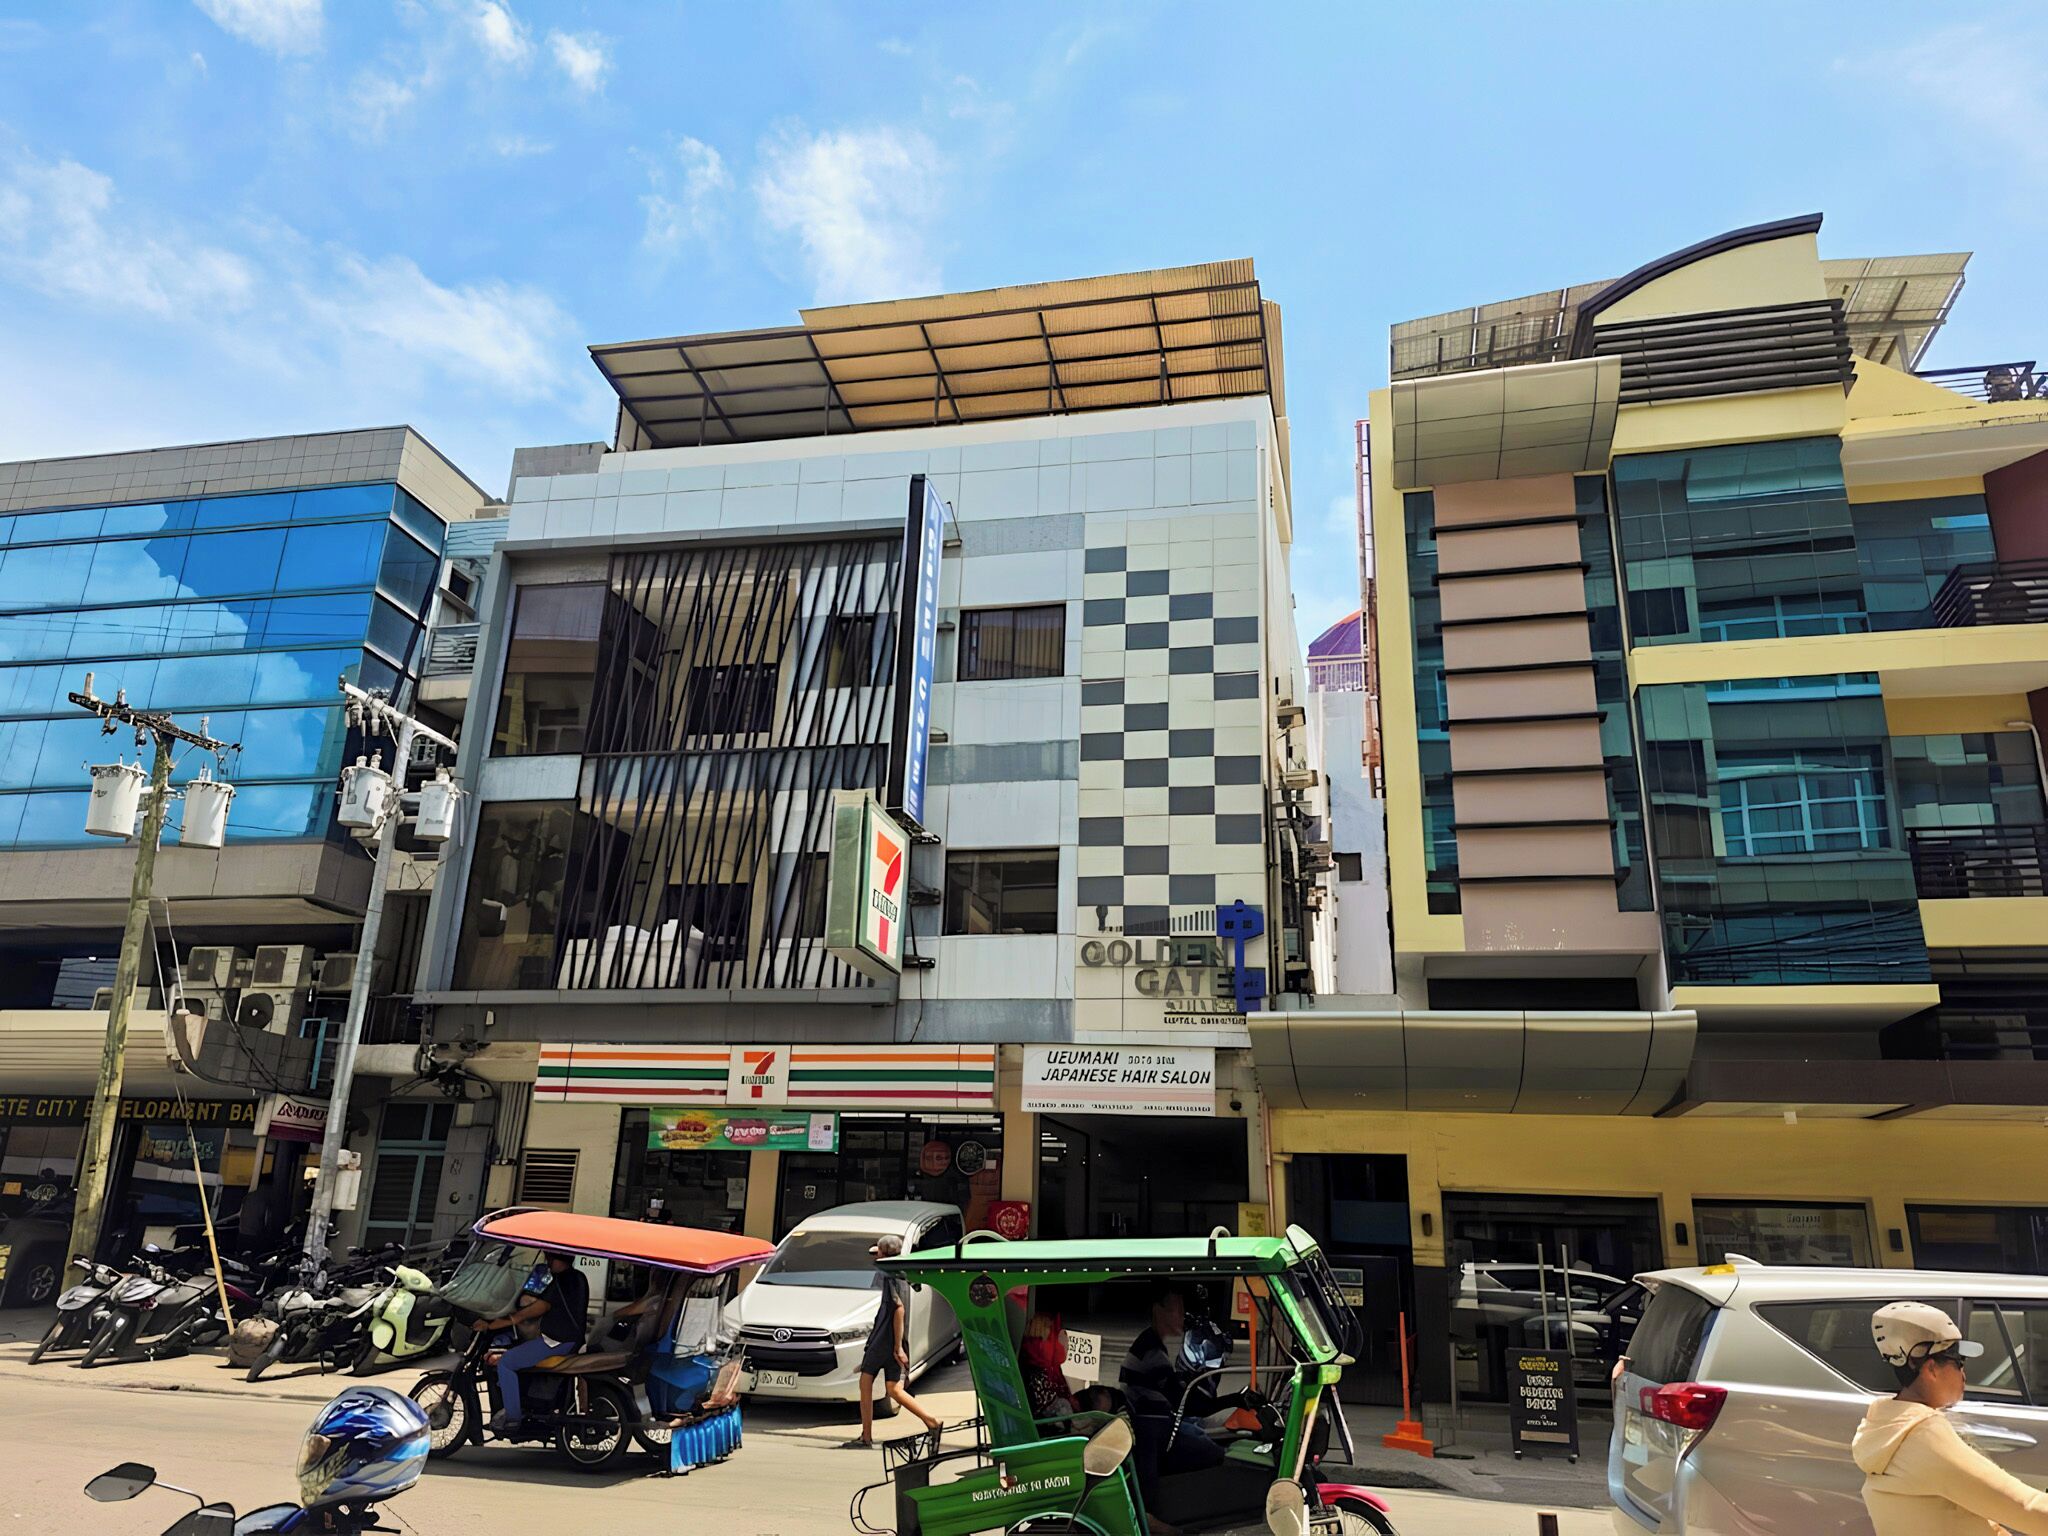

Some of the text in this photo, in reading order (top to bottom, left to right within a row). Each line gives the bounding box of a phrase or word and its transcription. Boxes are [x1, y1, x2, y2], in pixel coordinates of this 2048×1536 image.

[1041, 1068, 1117, 1083] JAPANESE
[1160, 1070, 1211, 1085] SALON
[36, 1099, 77, 1117] CITY
